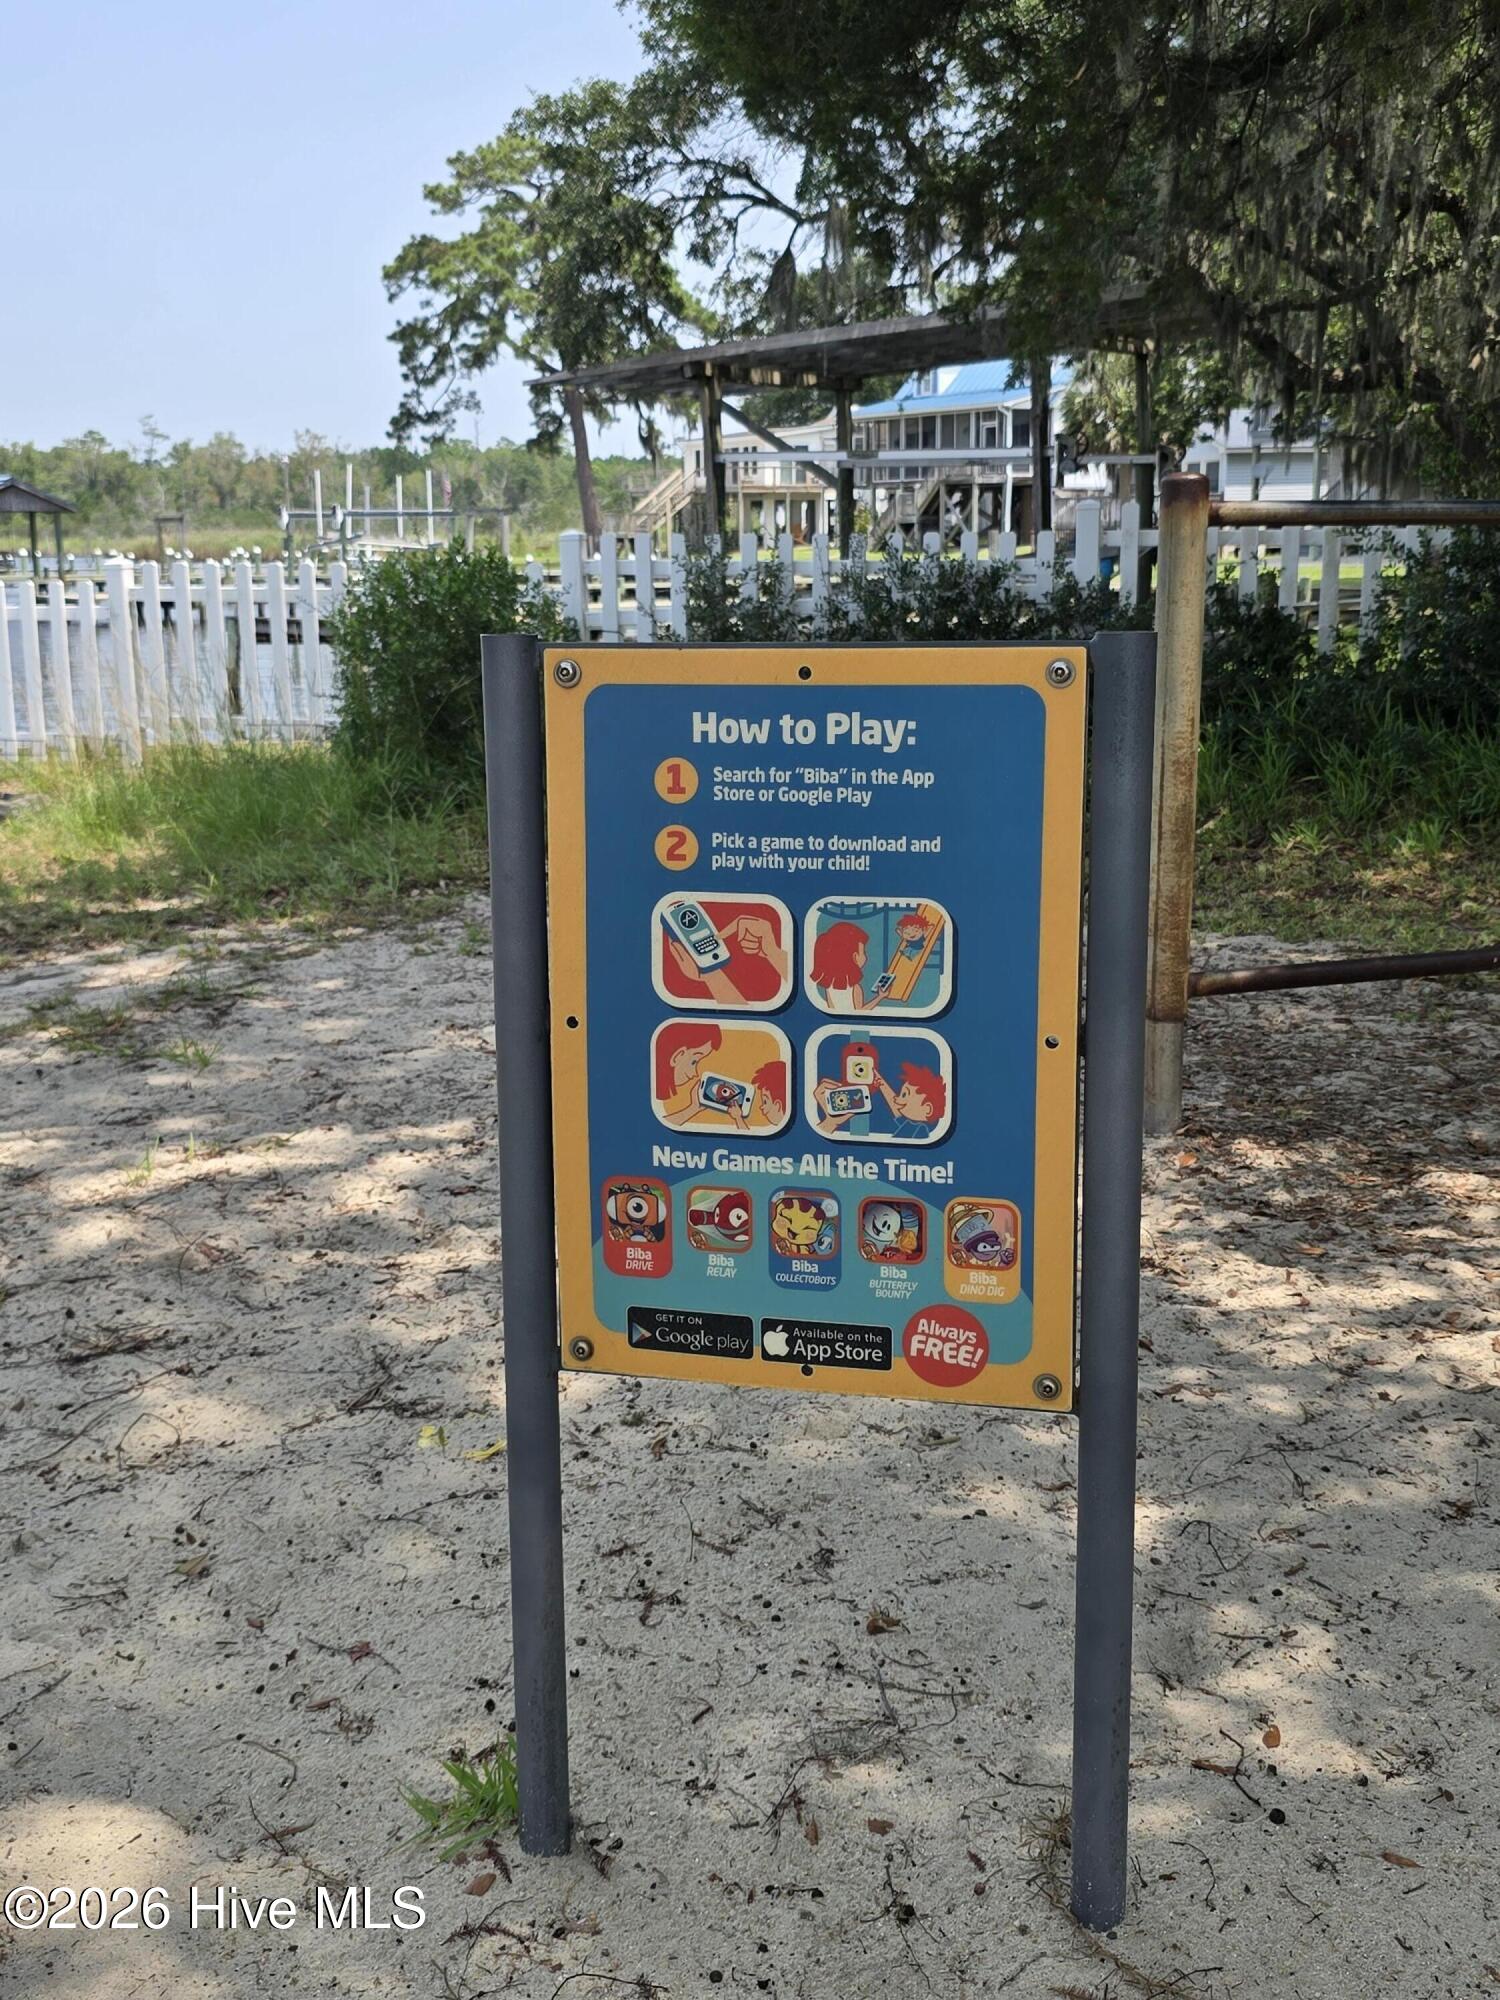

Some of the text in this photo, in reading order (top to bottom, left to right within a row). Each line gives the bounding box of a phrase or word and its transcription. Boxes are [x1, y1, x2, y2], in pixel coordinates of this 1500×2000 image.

[692, 712, 916, 753] How to Play:
[666, 764, 686, 794] 1
[713, 766, 765, 782] Search
[769, 767, 792, 783] for
[852, 768, 867, 784] in
[871, 769, 898, 784] the
[902, 770, 934, 788] App
[713, 786, 872, 807] Store or Google Play
[666, 830, 687, 861] 2
[712, 832, 940, 852] Pick a game to download and
[712, 853, 870, 872] play with your child!
[653, 1146, 954, 1184] New Games All the Time!
[627, 1248, 652, 1260] Biba
[709, 1254, 734, 1267] Biba
[626, 1260, 654, 1270] DRIVE
[707, 1267, 737, 1278] RELAY
[792, 1260, 818, 1273] Biba
[880, 1266, 907, 1279] Biba
[775, 1272, 837, 1285] COLLECTOBOTS
[869, 1279, 918, 1291] BUTTERFLY
[969, 1272, 997, 1285] Biba
[876, 1289, 912, 1299] BOUNTY
[960, 1286, 1005, 1297] DINO DIG
[656, 1314, 702, 1325] GET IT ON
[793, 1328, 882, 1343] Available on the
[918, 1319, 977, 1344] Always
[656, 1327, 749, 1353] Google play
[793, 1339, 882, 1362] App Store
[910, 1335, 984, 1369] FREE!
